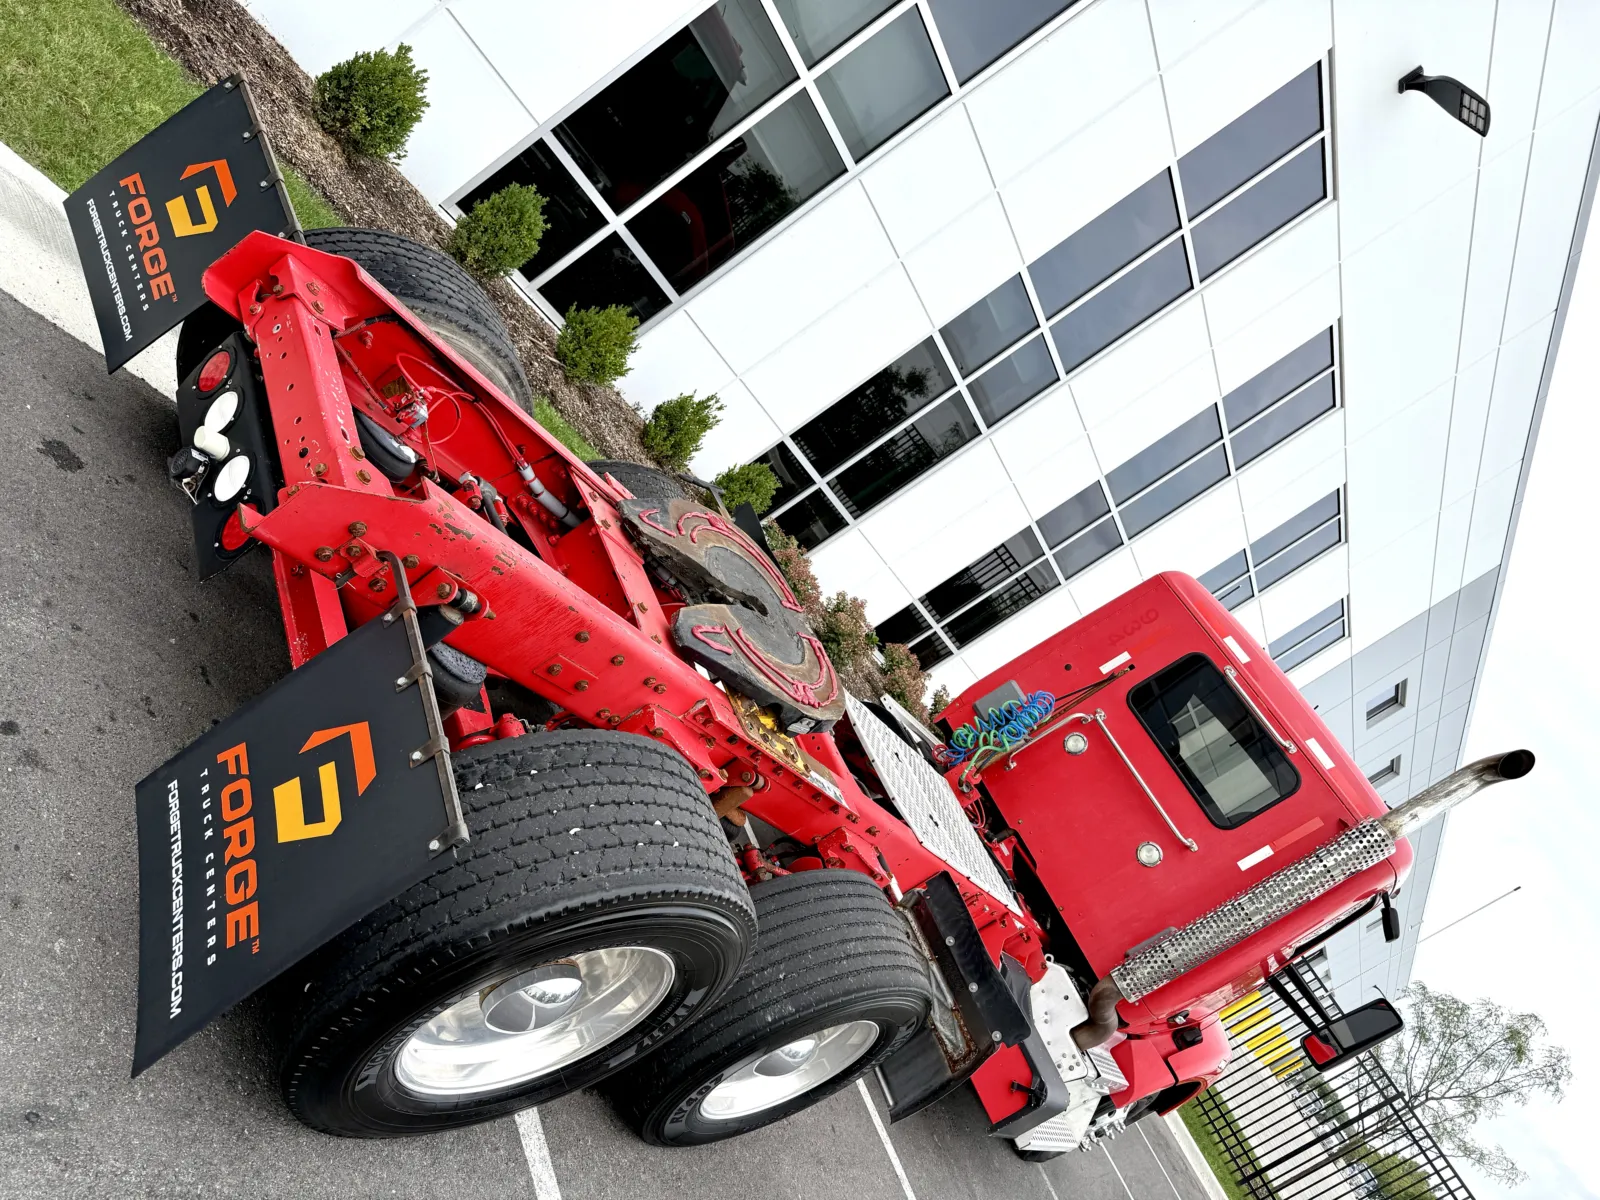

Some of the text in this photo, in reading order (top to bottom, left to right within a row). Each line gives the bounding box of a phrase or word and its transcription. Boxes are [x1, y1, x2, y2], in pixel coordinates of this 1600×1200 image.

[86, 197, 134, 342] FORGETRUCKCENTERS.COM
[108, 190, 149, 312] TRUCK CENTERS
[119, 172, 175, 300] FORGE
[167, 778, 184, 1020] FORGETRUCKCENTERS.COM
[199, 767, 217, 966] TRUCK CENTERS
[216, 742, 260, 949] FORGE
